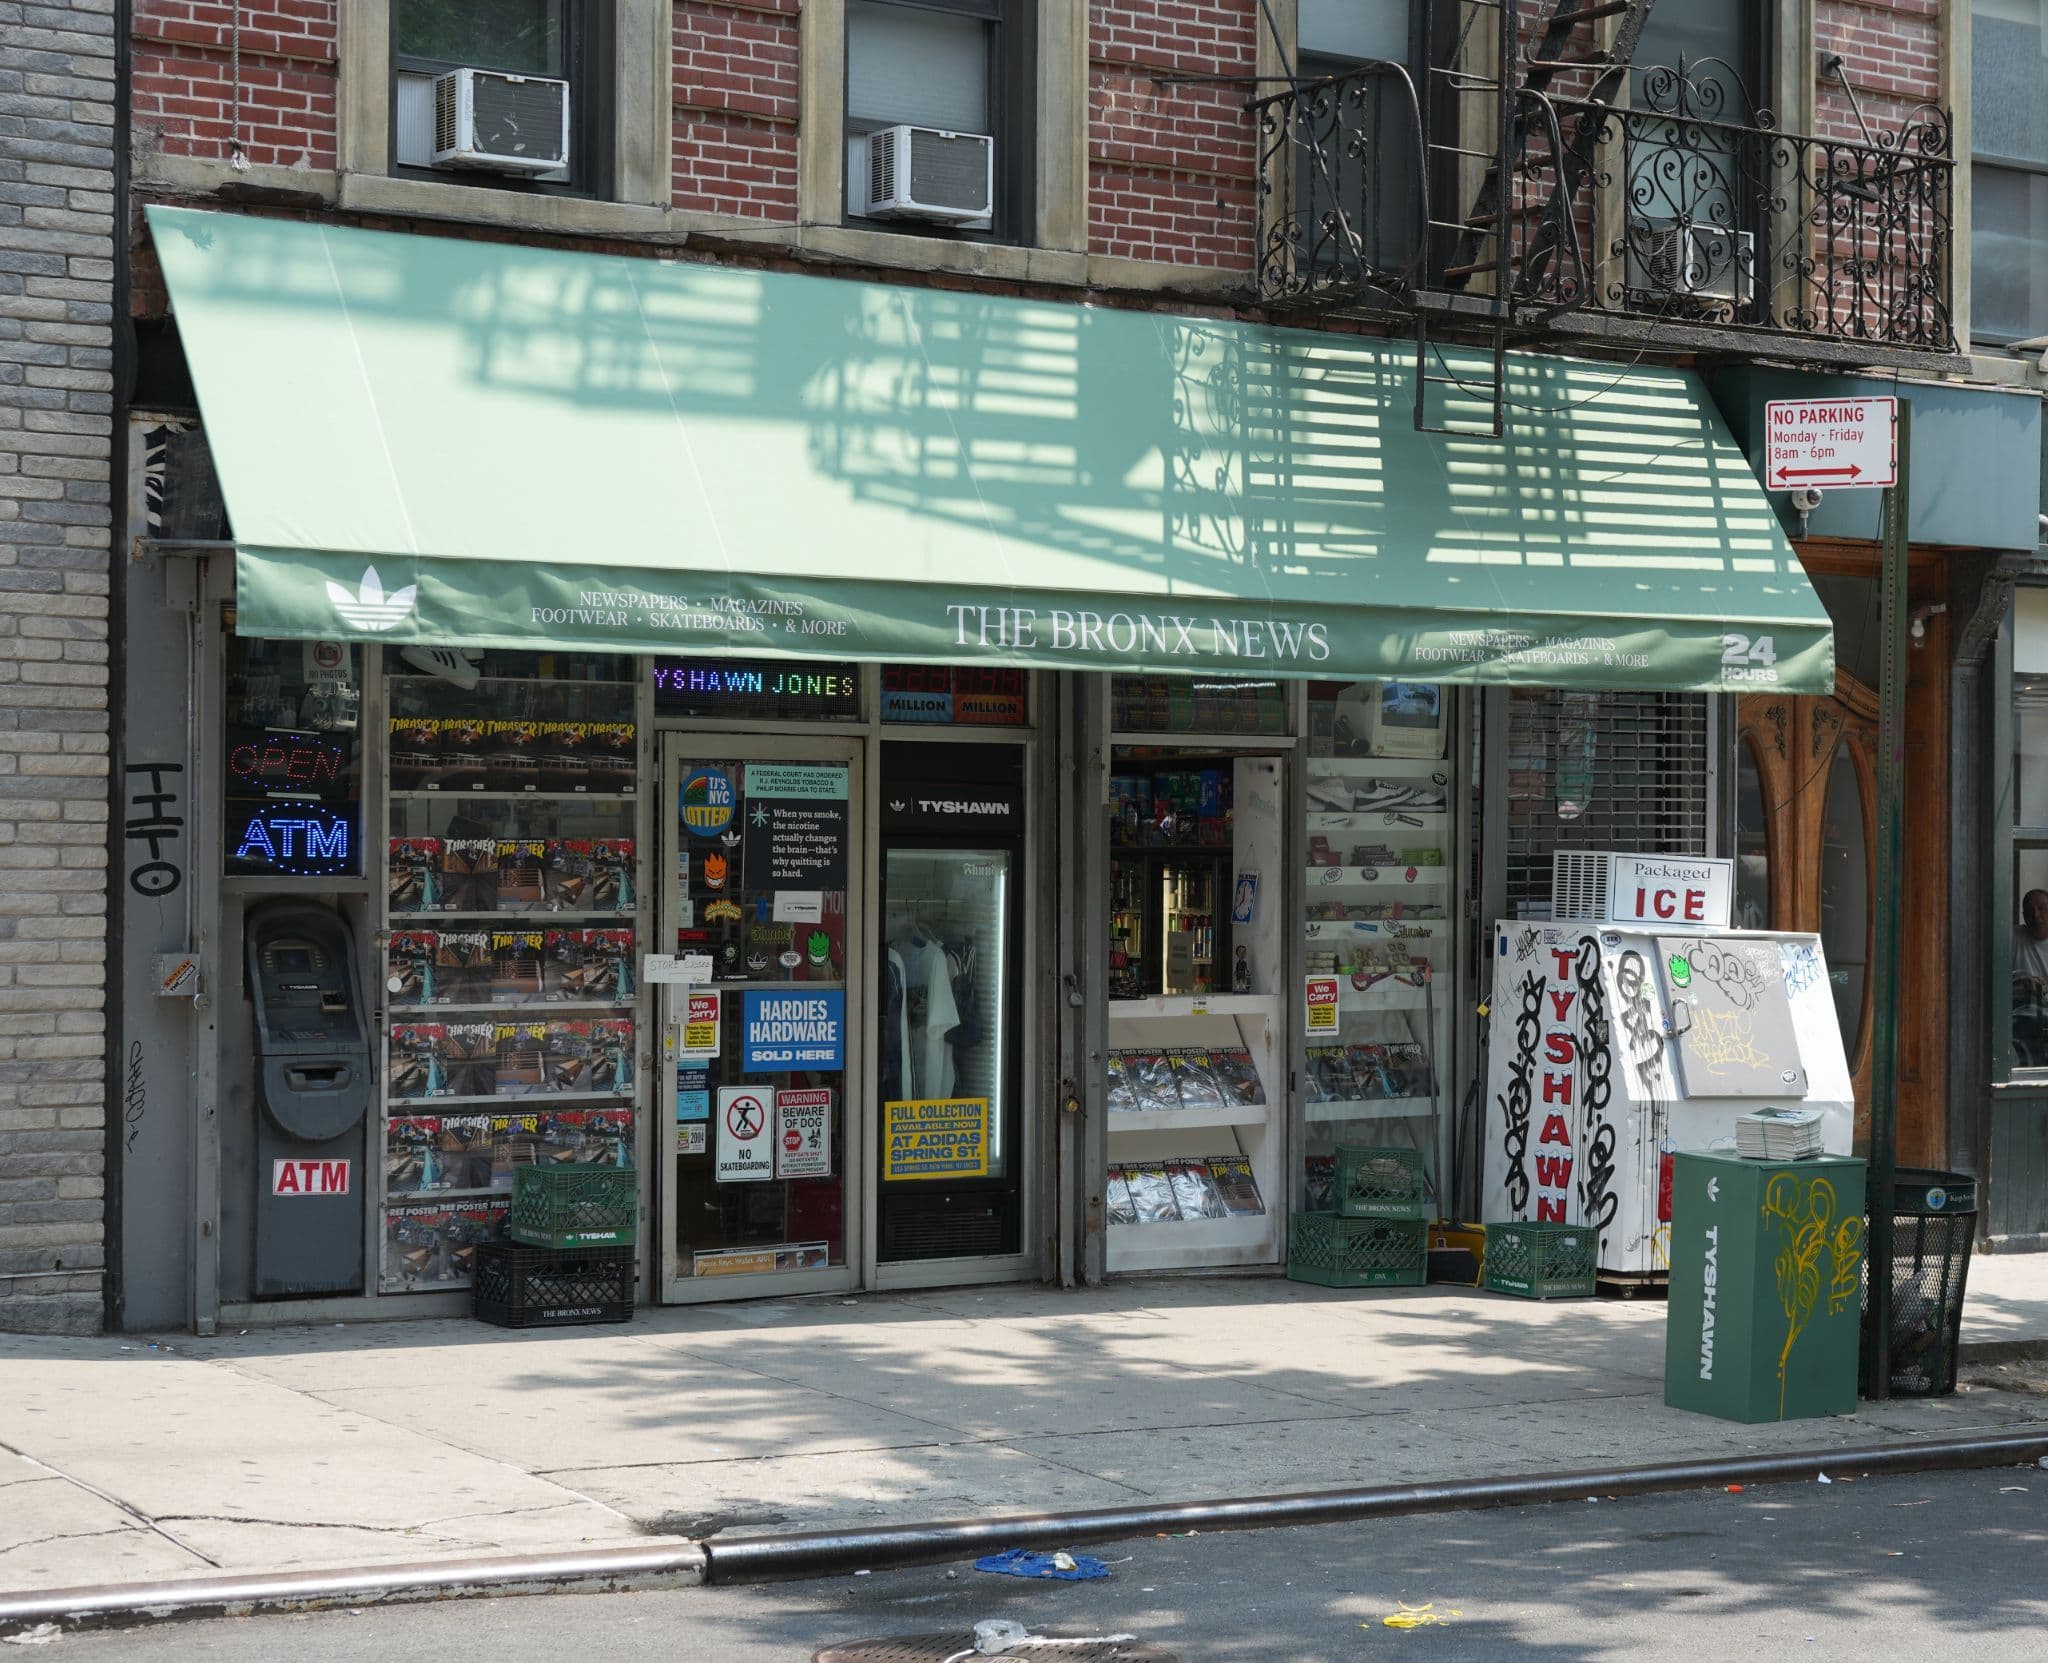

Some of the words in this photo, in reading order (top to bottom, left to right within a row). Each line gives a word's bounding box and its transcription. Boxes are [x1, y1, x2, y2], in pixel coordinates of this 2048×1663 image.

[1774, 410, 1794, 425] NO
[1800, 407, 1864, 424] PARKING
[1774, 430, 1817, 445] Monday
[1829, 428, 1864, 443] Friday
[1774, 447, 1798, 460] 8am
[1810, 446, 1835, 460] 6pm
[580, 591, 688, 611] NEWSPAPERS
[711, 597, 803, 617] MAGAZINES
[531, 608, 628, 626] FOOTWEAR
[650, 614, 765, 632] SKATEBOARDS
[785, 618, 796, 633] &
[801, 619, 847, 636] MORE
[946, 604, 1037, 648] THE
[1049, 609, 1200, 655] BRONX
[1209, 617, 1331, 661] NEWS
[1449, 632, 1530, 649] NEWSPAPERS
[1545, 635, 1616, 652] MAGAZINES
[1721, 633, 1776, 666] 24
[1415, 647, 1485, 663] FOOTWEAR
[1500, 650, 1588, 666] SKATEBOARDS
[1604, 654, 1612, 666] &
[1615, 654, 1649, 668] MORE
[320, 669, 347, 679] PHOTOS
[1721, 666, 1779, 682] HOURS
[772, 674, 853, 697] JONES
[889, 699, 946, 712] MILLION
[961, 702, 1017, 714] MILLION
[231, 743, 342, 781] OPEN
[709, 776, 727, 791] TJ'S
[709, 790, 730, 805] NYC
[773, 808, 797, 818] When
[798, 811, 813, 821] you
[814, 810, 841, 820] smoke,
[918, 800, 1009, 815] TYSHAWN
[682, 806, 732, 828] LOTTERY
[773, 820, 786, 830] the
[787, 821, 820, 830] nicotine
[236, 818, 348, 858] ATM
[772, 833, 805, 844] actually
[805, 833, 837, 844] changes
[772, 845, 786, 854] the
[772, 857, 790, 867] why
[790, 857, 823, 868] quitting
[823, 858, 831, 866] is
[782, 869, 804, 878] hard.
[1634, 862, 1711, 881] Packaged
[1635, 886, 1706, 922] ICE
[492, 933, 544, 952] THRHER
[1314, 984, 1330, 994] We
[1308, 992, 1336, 1002] Carry
[690, 1000, 709, 1010] We
[760, 1000, 828, 1021] HARDIES
[750, 1022, 837, 1043] HARDWARE
[751, 1050, 793, 1062] SOLD
[795, 1049, 835, 1061] HERE
[1108, 1049, 1121, 1057] TER
[1536, 946, 1579, 1223] TYSHAWN
[781, 1093, 827, 1104] WARNING
[782, 1106, 824, 1118] BEWARE
[891, 1106, 915, 1120] FULL
[918, 1103, 981, 1119] COLLECTION
[785, 1118, 798, 1129] OF
[800, 1117, 822, 1128] DOG
[895, 1122, 951, 1131] AVAILABLE
[953, 1120, 978, 1129] NOW
[783, 1136, 801, 1145] STOP
[891, 1135, 913, 1148] AT
[917, 1132, 981, 1147] ADIDAS
[738, 1148, 752, 1160] NO
[891, 1147, 952, 1161] SPRING
[957, 1146, 981, 1157] ST.
[720, 1161, 770, 1172] SKATEBOARDING
[277, 1162, 347, 1192] ATM
[389, 1208, 405, 1217] REE
[405, 1206, 438, 1217] POSTER
[456, 1202, 488, 1212] POSTER
[1699, 1225, 1718, 1381] TYSHAWN
[543, 1310, 556, 1318] THE
[557, 1308, 580, 1317] BRONX
[581, 1307, 602, 1316] NEWS
